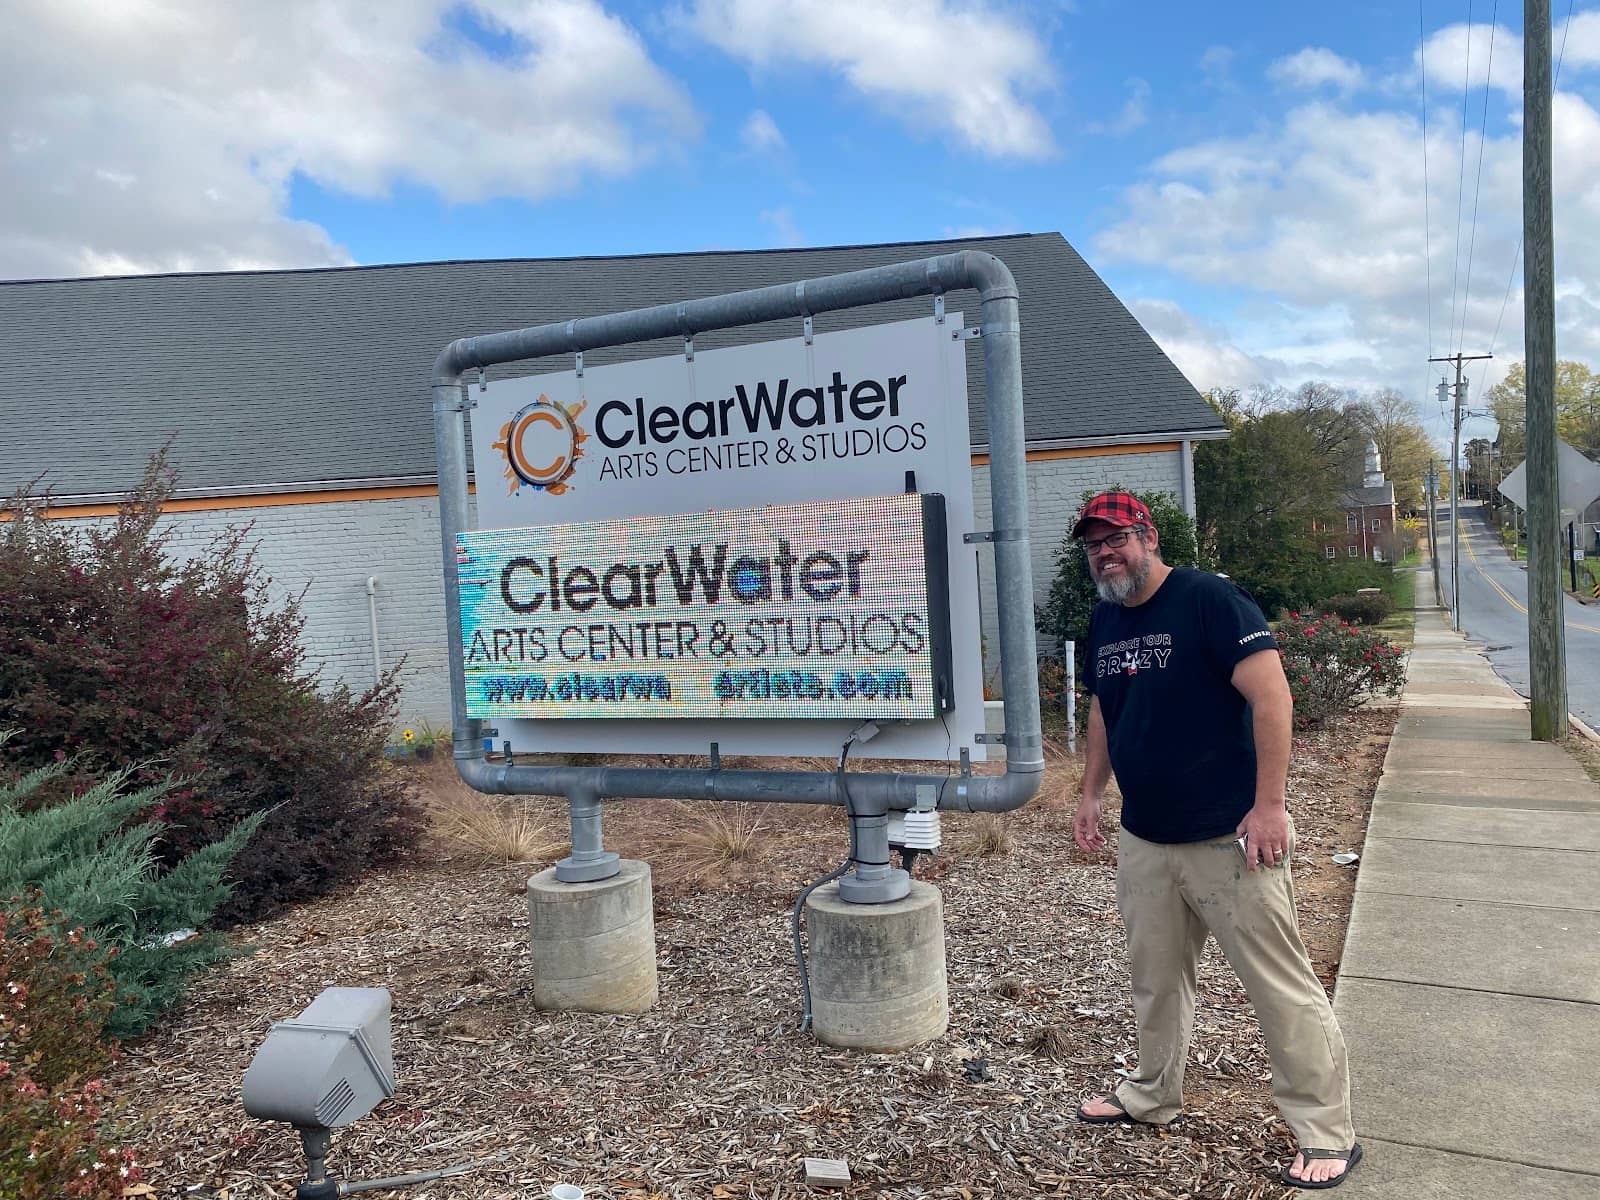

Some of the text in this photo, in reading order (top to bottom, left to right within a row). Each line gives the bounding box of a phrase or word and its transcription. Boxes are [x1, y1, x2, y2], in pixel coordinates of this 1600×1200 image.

[594, 371, 907, 449] ClearWater
[599, 422, 927, 482] ARTS CENTER & STUDIOS
[500, 538, 870, 615] ClearWater
[467, 612, 925, 664] ARTS CENTER & STUDIOS
[1097, 648, 1172, 677] CRZY
[1098, 637, 1140, 658] EXPLORE
